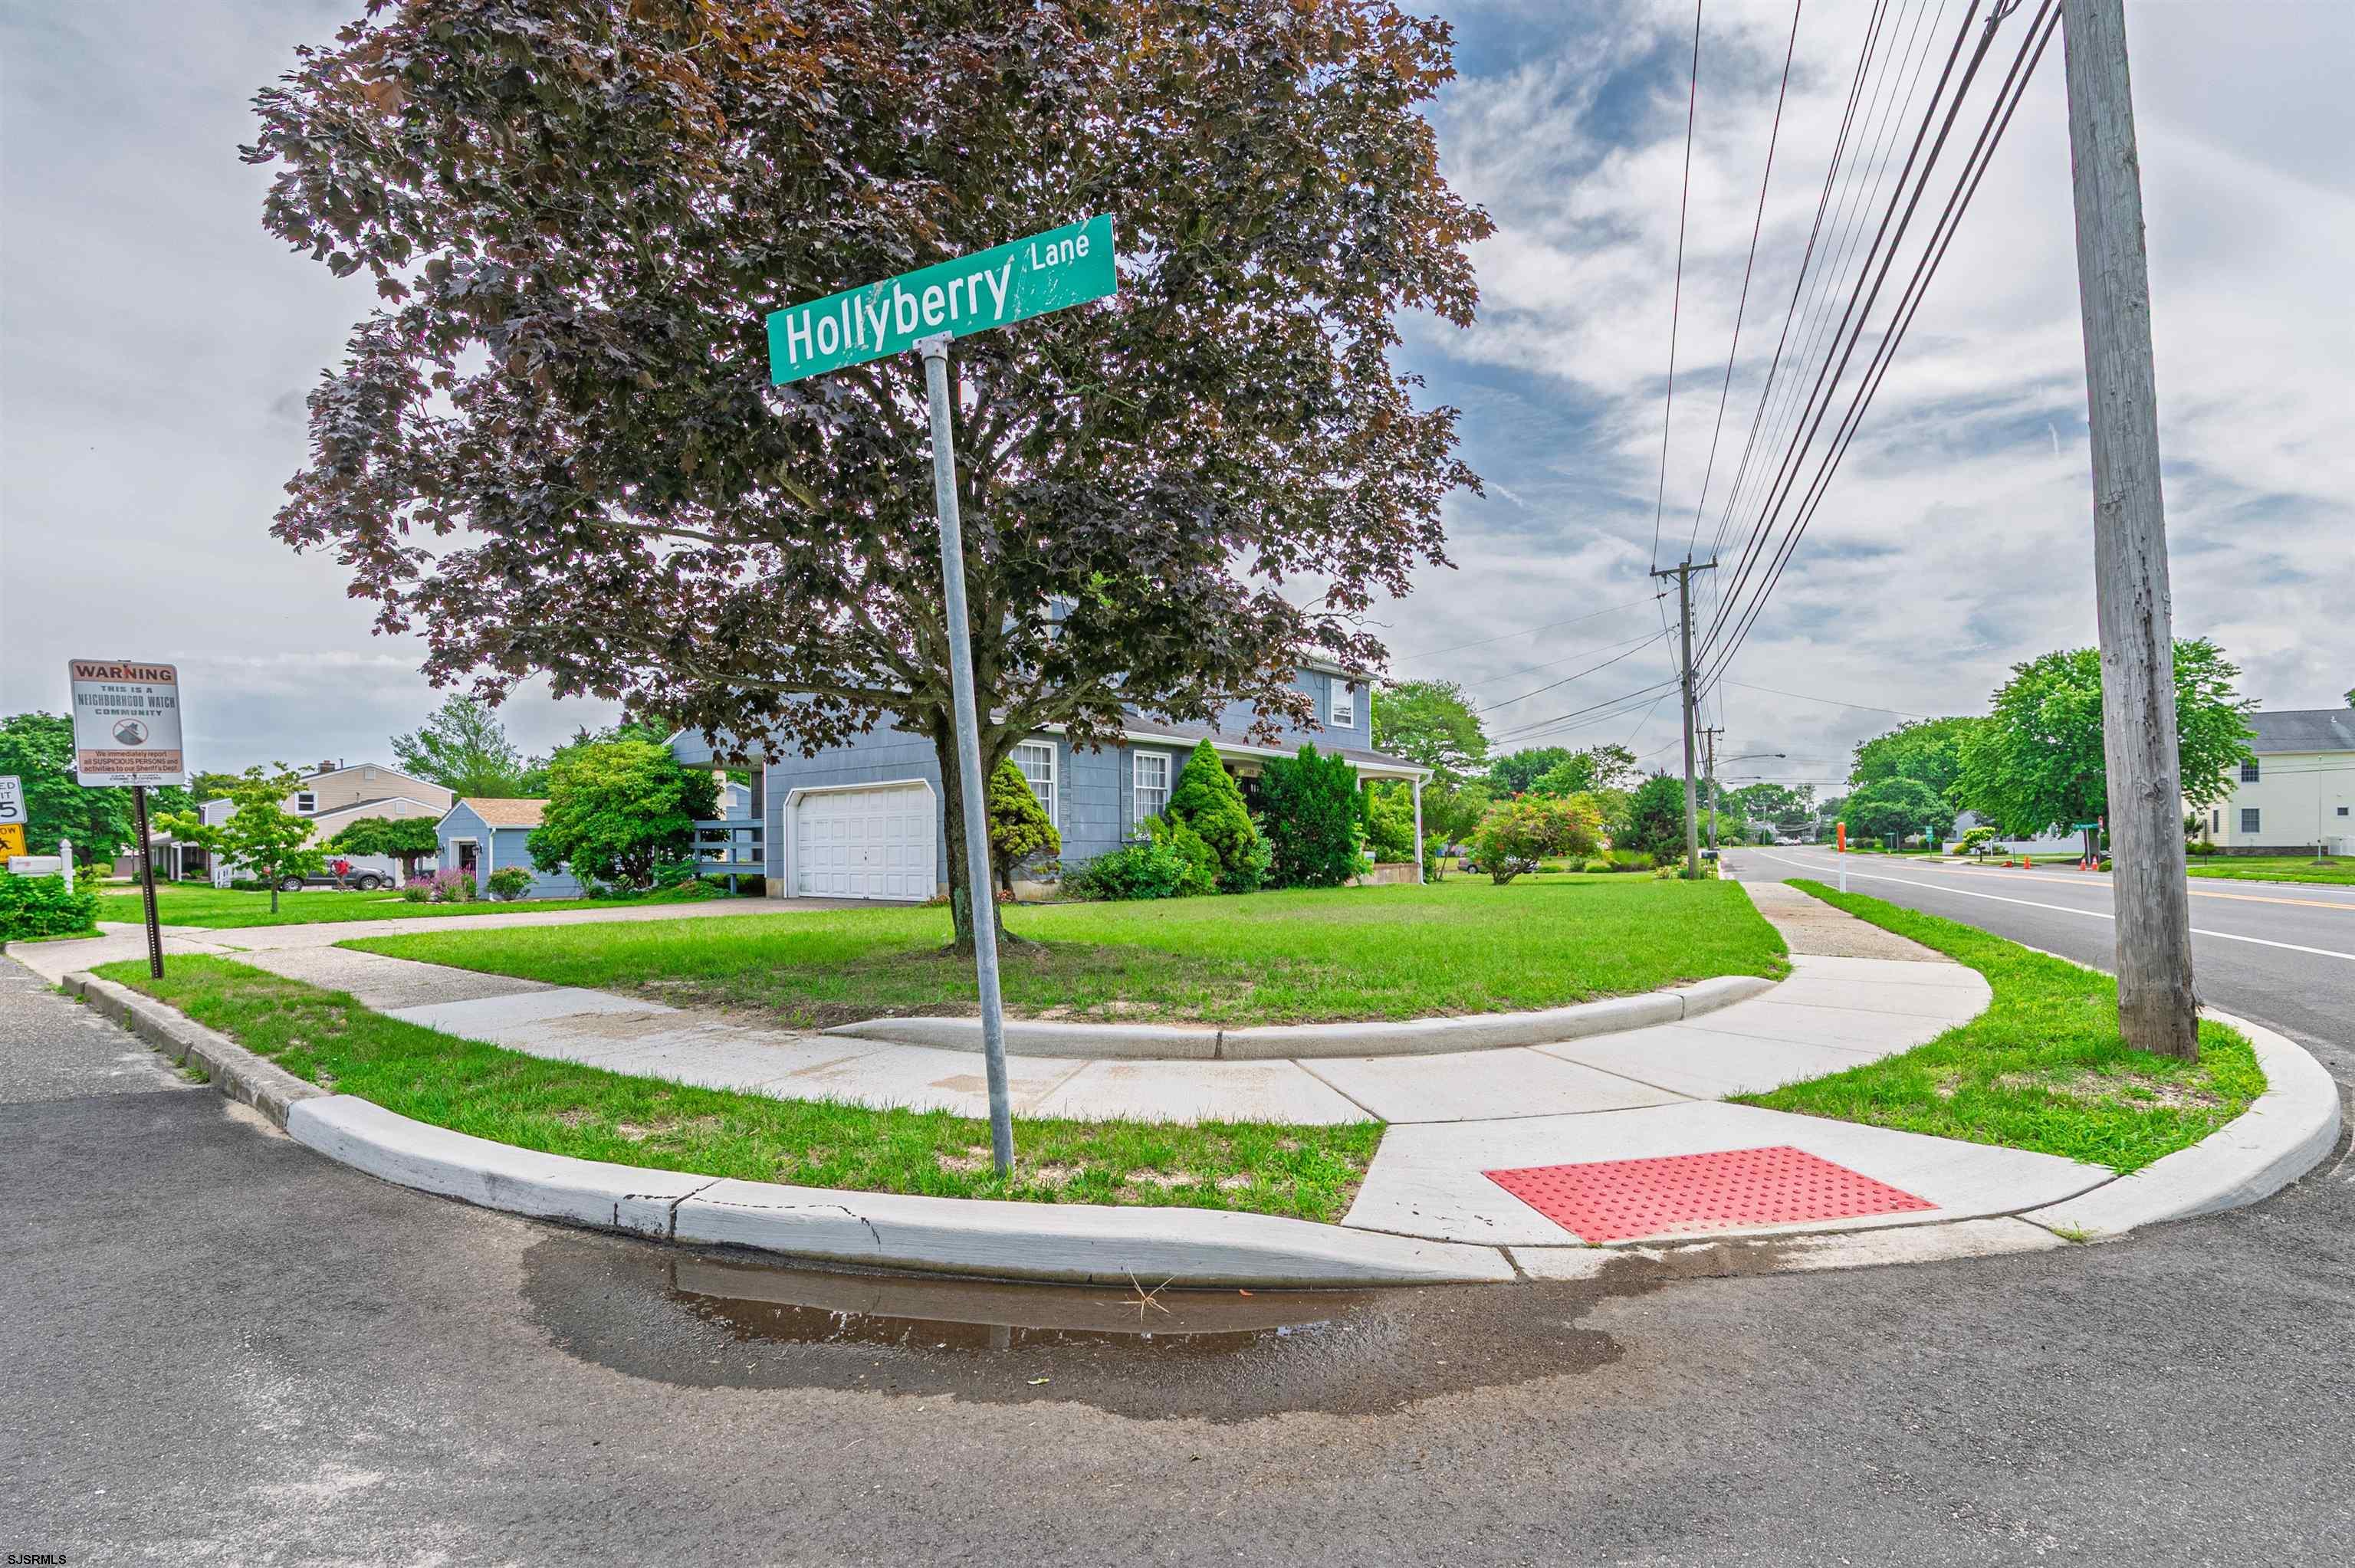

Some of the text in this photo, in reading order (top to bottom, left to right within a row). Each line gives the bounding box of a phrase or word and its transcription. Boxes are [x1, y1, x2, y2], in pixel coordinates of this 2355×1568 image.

[786, 232, 1089, 364] Hollyberry Lane
[75, 665, 172, 681] WARNING
[77, 694, 176, 708] NEIGHBORHOOD WATCH
